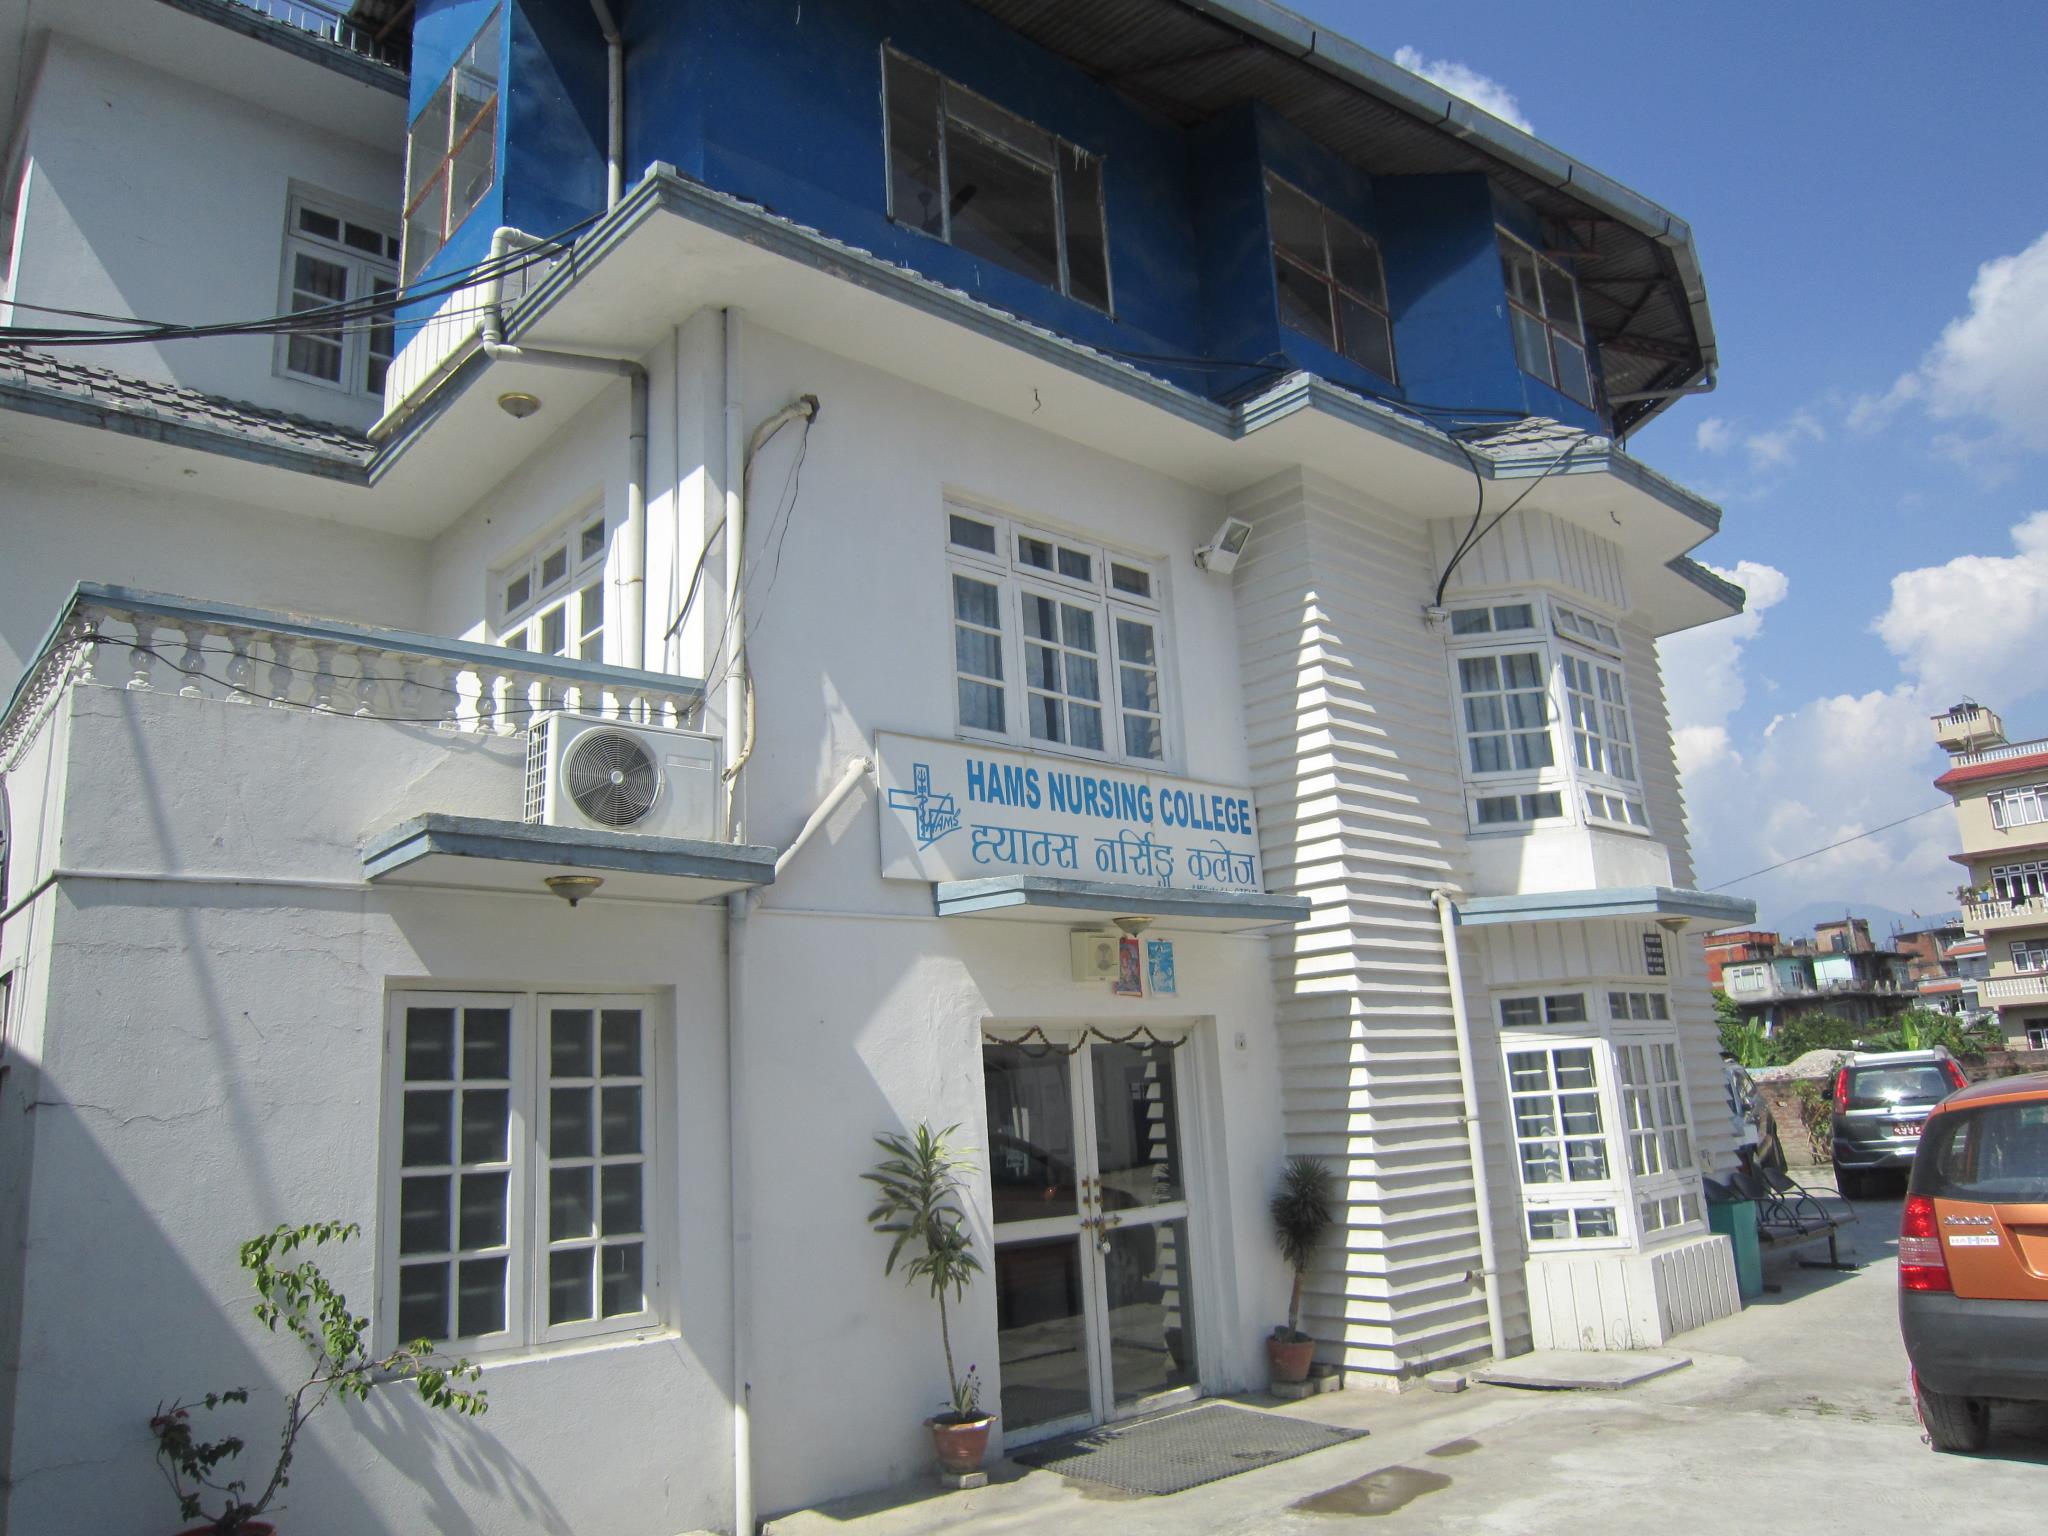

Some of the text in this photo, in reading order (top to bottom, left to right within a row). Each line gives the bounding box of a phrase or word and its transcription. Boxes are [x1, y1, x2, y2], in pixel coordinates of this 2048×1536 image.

[966, 759, 1252, 836] HAMS NURSING COLLEGE
[1186, 839, 1256, 885] कलेज
